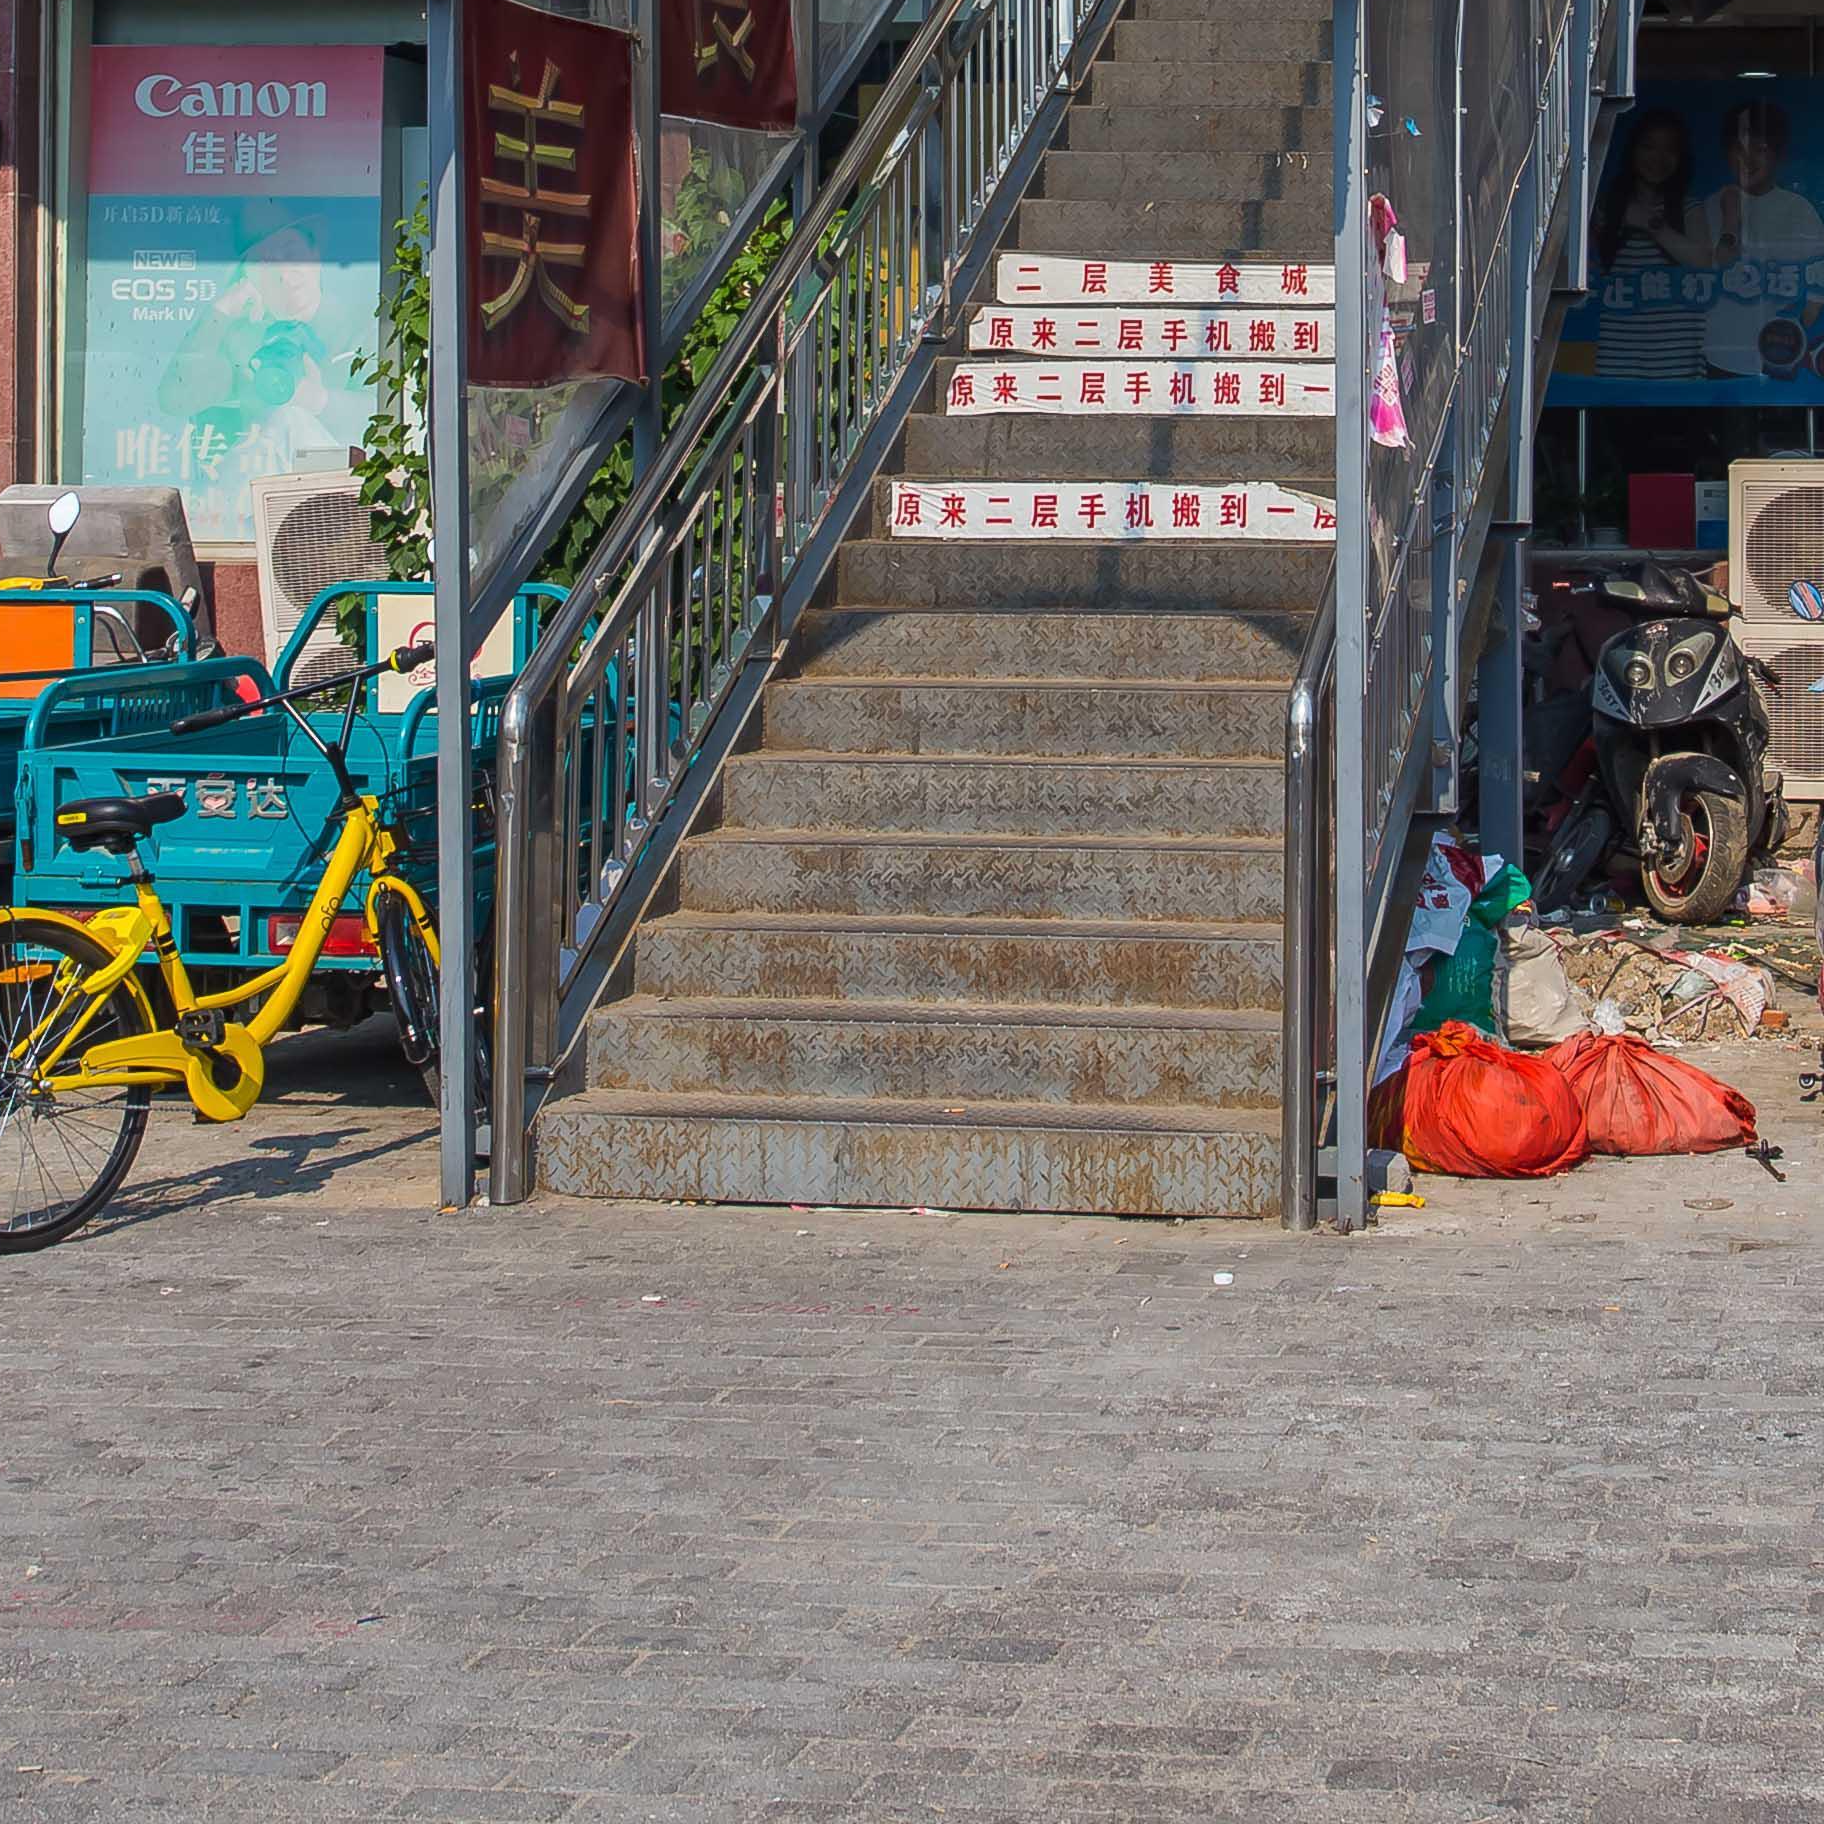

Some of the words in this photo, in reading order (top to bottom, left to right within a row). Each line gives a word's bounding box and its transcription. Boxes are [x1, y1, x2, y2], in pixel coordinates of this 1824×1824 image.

[134, 74, 328, 119] Canon
[181, 132, 279, 175] 佳能
[480, 48, 593, 338] 美
[111, 279, 175, 302] EOS
[184, 279, 217, 302] 5D
[1015, 263, 1309, 297] 二层美食城
[132, 307, 175, 322] Mark
[177, 307, 196, 321] IV
[987, 317, 1322, 355] 原来二层手机搬到
[949, 372, 1332, 409] 原来二层手机搬到一
[321, 896, 342, 935] ofo
